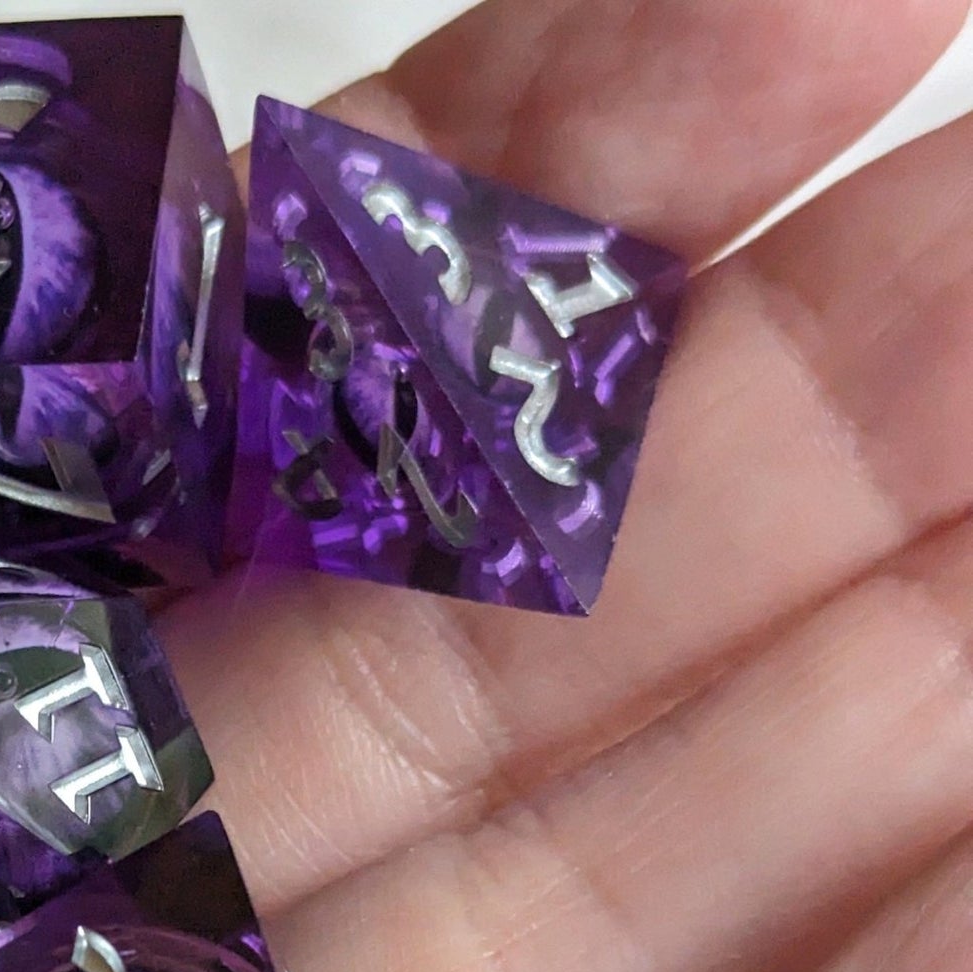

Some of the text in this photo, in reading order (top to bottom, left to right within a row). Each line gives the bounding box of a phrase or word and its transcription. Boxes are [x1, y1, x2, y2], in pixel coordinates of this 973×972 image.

[361, 181, 472, 304] 3
[526, 253, 633, 338] 1
[14, 642, 164, 824] 11
